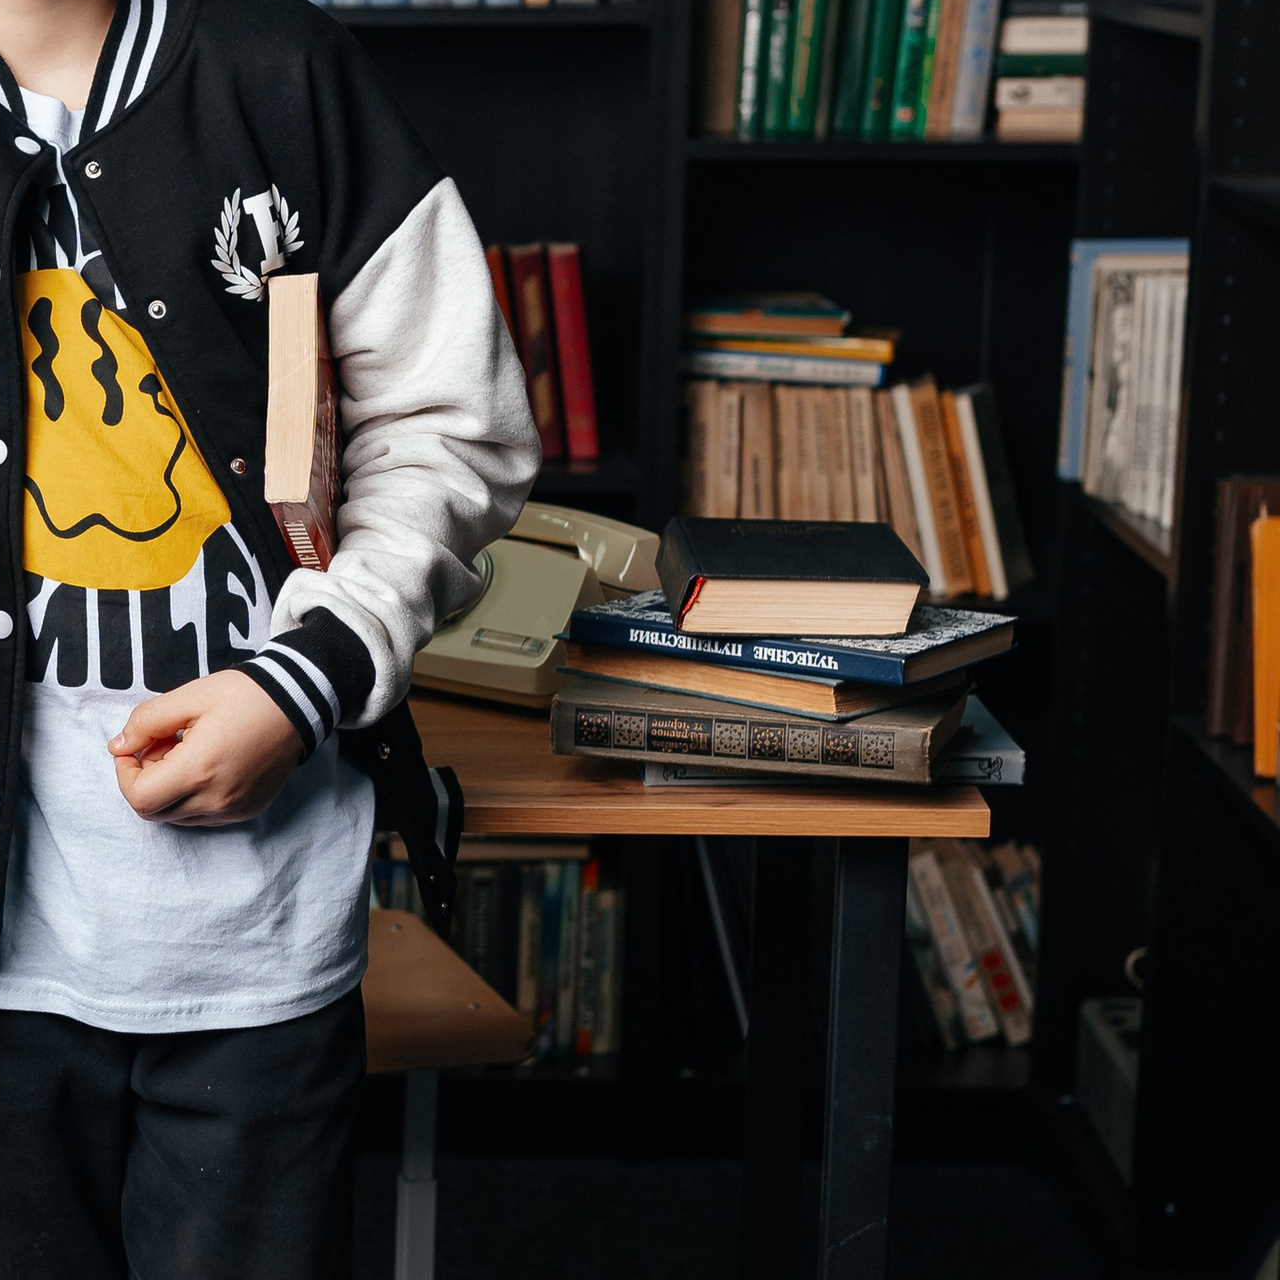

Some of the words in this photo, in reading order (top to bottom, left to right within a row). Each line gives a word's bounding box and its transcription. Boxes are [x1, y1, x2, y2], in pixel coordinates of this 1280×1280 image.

[24, 523, 262, 695] MILE
[629, 628, 743, 658] ПУТЕШЕСТВИЯ
[752, 645, 839, 671] ЧУДЕСНЫЕ
